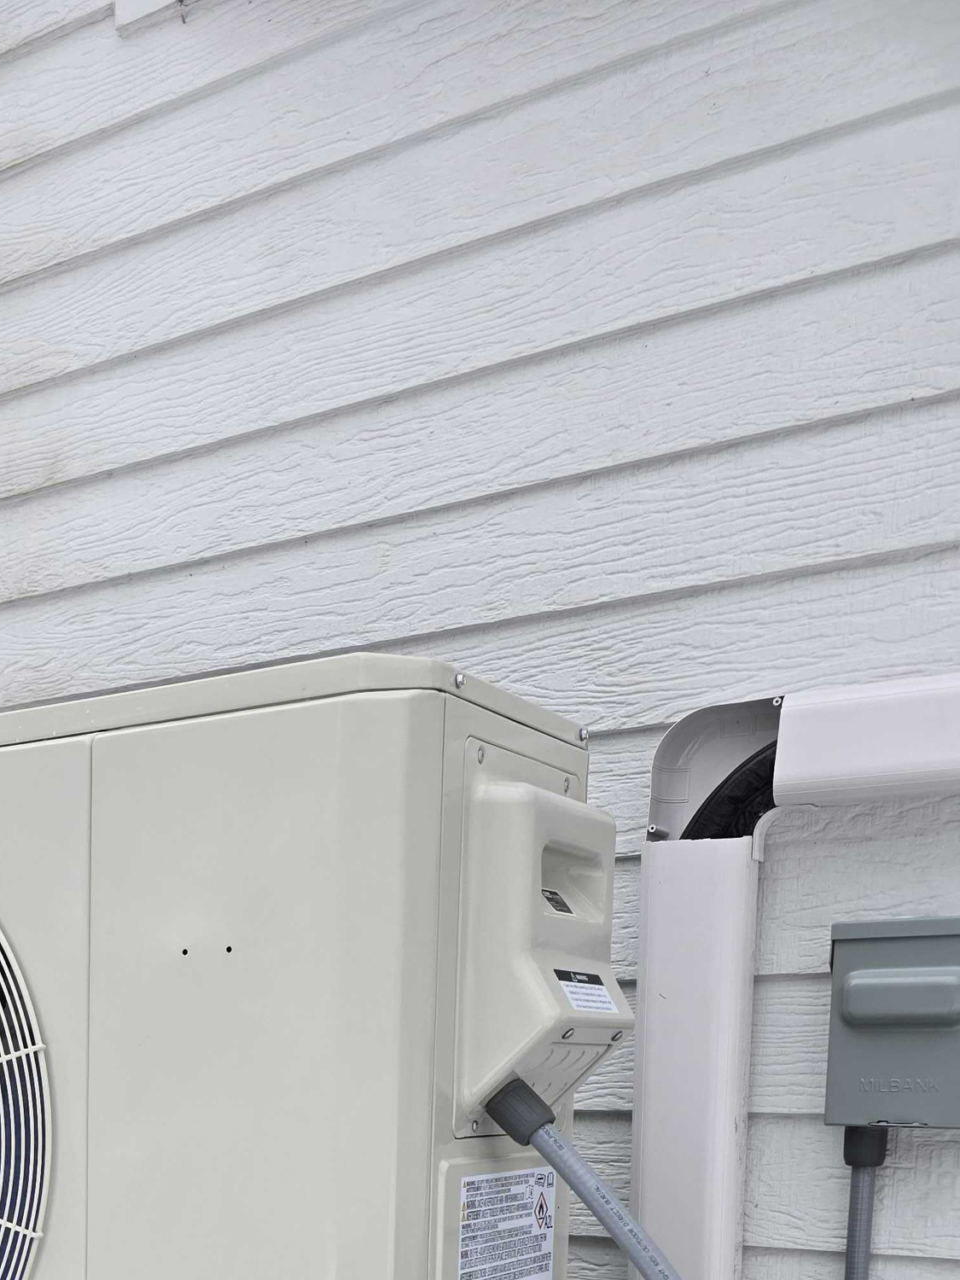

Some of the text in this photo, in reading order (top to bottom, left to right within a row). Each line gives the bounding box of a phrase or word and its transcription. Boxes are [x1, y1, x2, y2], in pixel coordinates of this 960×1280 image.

[858, 1077, 940, 1093] MILBANK
[593, 1185, 612, 1205] BURIAL
[610, 1206, 629, 1226] DIRECT
[628, 1228, 649, 1253] OUTDOOR
[649, 1254, 659, 1266] RES
